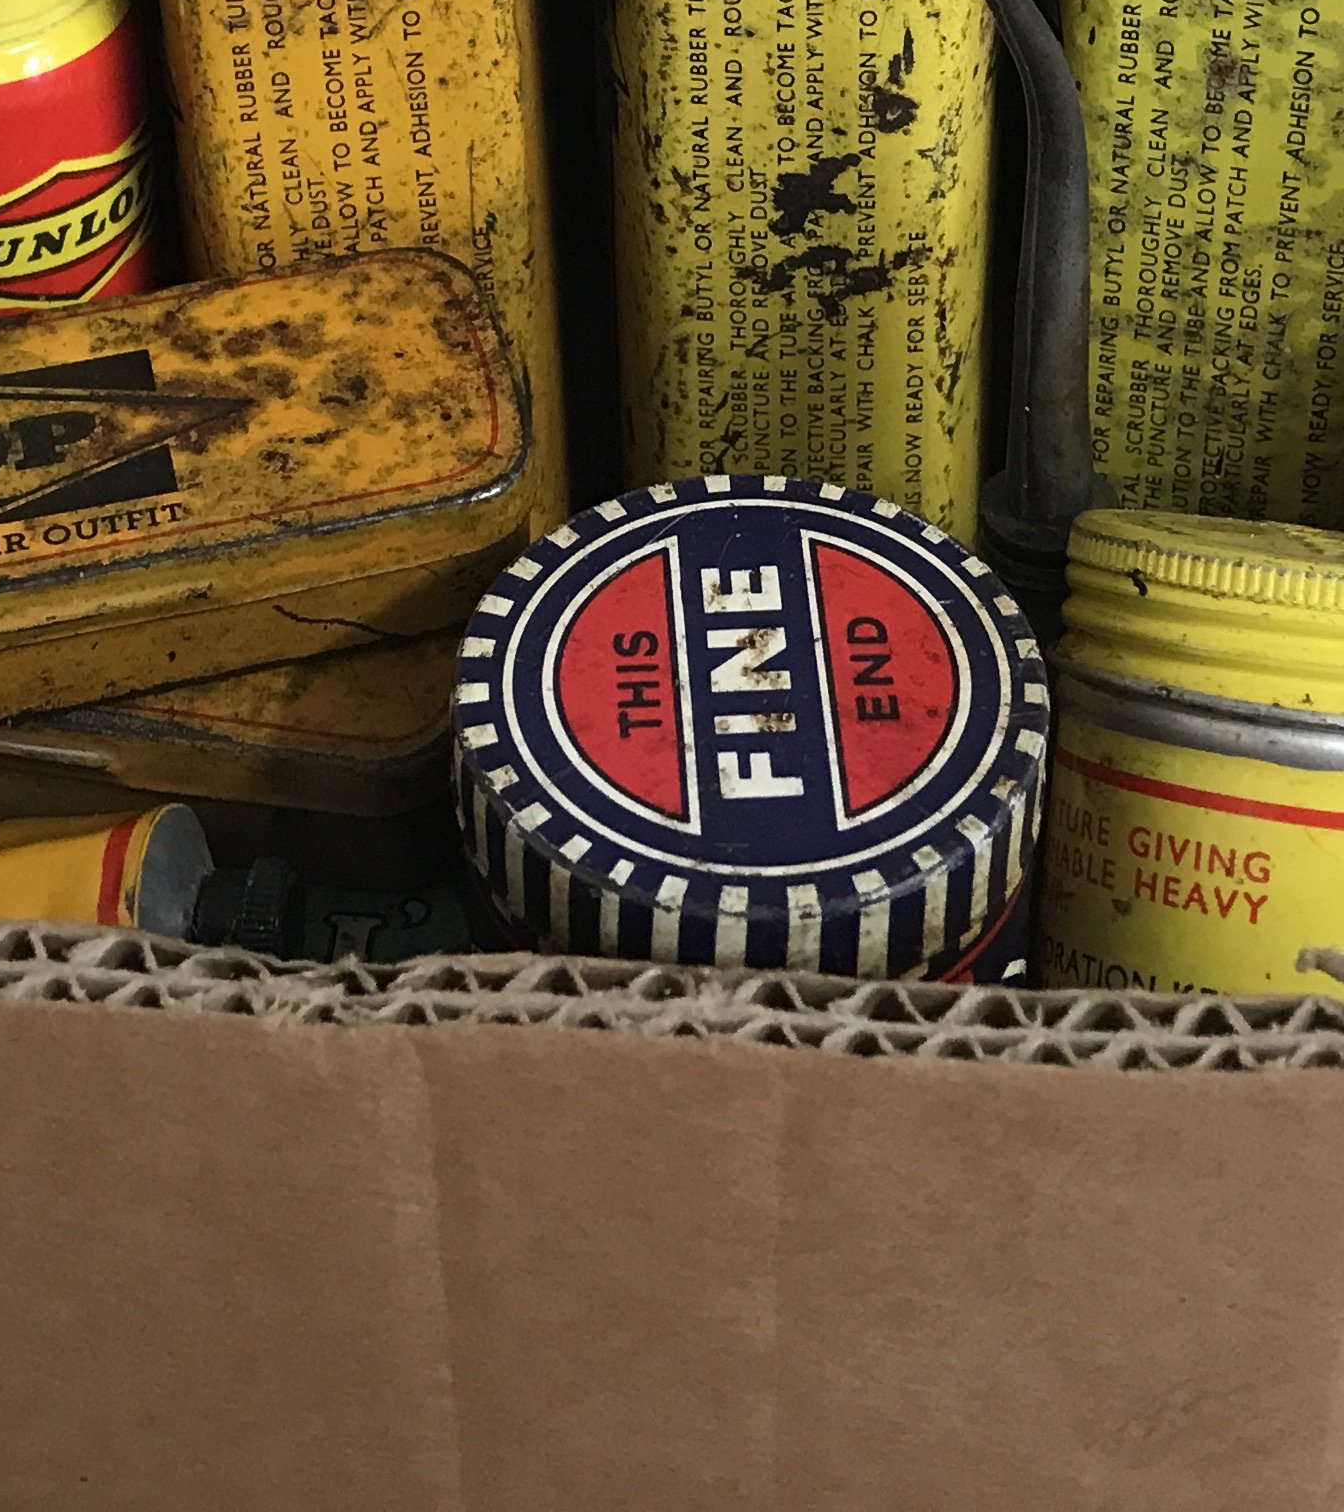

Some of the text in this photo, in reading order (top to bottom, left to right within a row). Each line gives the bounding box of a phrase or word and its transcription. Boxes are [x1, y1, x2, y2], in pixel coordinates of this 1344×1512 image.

[401, 10, 421, 37] TO
[860, 10, 877, 40] TO
[1118, 4, 1142, 84] RUBBER
[1299, 8, 1320, 38] TO
[232, 42, 258, 122] RUBBER
[271, 71, 294, 118] AND
[323, 48, 348, 132] BECOME
[352, 53, 375, 114] APPLY
[688, 27, 708, 105] RUBBER
[724, 59, 742, 106] AND
[776, 43, 795, 125] BECOME
[806, 49, 824, 110] APPLY
[1155, 40, 1174, 89] AND
[1237, 39, 1260, 104] APPLY
[406, 52, 432, 157] ADHESION
[1231, 110, 1252, 158] AND
[1286, 50, 1315, 162] ADHESION
[332, 142, 352, 170] TO
[359, 121, 380, 166] AND
[691, 116, 711, 212] NATURAL
[726, 126, 744, 192] CLEAN
[777, 138, 795, 165] TO
[807, 118, 824, 162] AND
[1111, 95, 1135, 194] NATURAL
[1147, 109, 1169, 177] CLEAN
[1201, 125, 1221, 155] TO
[243, 132, 272, 230] NATURAL
[278, 138, 304, 205] CLEAN
[307, 172, 329, 229] DUST.
[750, 164, 767, 220] DUST.
[1224, 167, 1248, 235] PATCH
[337, 181, 360, 253] ALLOW
[363, 176, 387, 242] PATCH
[858, 171, 876, 257] PREVENT
[1108, 206, 1126, 234] OR
[1194, 164, 1217, 241] ALLOW
[1275, 171, 1301, 262] PREVENT
[257, 240, 276, 268] OR
[694, 223, 711, 251] OR
[1133, 196, 1162, 339] THOROUGHLY
[695, 261, 714, 321] BUTYL
[1103, 244, 1125, 306] BUTYL
[1192, 251, 1210, 297] AND
[1220, 242, 1240, 297] FROM
[1240, 264, 1263, 331] EDGES.
[1271, 273, 1290, 300] TO
[752, 319, 769, 362] AND
[779, 312, 797, 359] TUBE
[807, 308, 824, 394] BACKING
[829, 338, 846, 361] AT
[857, 306, 874, 371] CHALK
[1143, 150, 1190, 509] THE PUNCTURE AND REMOVE DUST.
[1185, 306, 1205, 355] TUBE
[1212, 307, 1234, 396] BACKING
[1239, 339, 1255, 365] AT
[1263, 313, 1287, 380] CHALK
[1317, 332, 1339, 370] FOR
[697, 332, 715, 429] REPAIRING
[780, 370, 797, 404] THE
[1095, 317, 1119, 416] REPAIRING
[1181, 366, 1200, 402] THE
[731, 370, 749, 462] SCRUBBER
[753, 371, 771, 470] PUNCTURE
[780, 413, 797, 439] TO
[856, 382, 873, 432] WITH
[905, 316, 924, 505] IS NOW READY FOR
[1126, 360, 1149, 454] SCRUBBER
[1177, 411, 1195, 438] TO
[1257, 391, 1278, 443] WITH
[1309, 380, 1331, 443] READY
[1093, 427, 1111, 462] FOR
[1302, 453, 1321, 504] NOW
[43, 502, 184, 547] OUTFIT
[613, 629, 664, 739] THIS
[699, 564, 805, 800] FINE
[846, 614, 901, 722] END
[1128, 825, 1272, 884] GIVING
[1133, 867, 1268, 925] HEAVY
